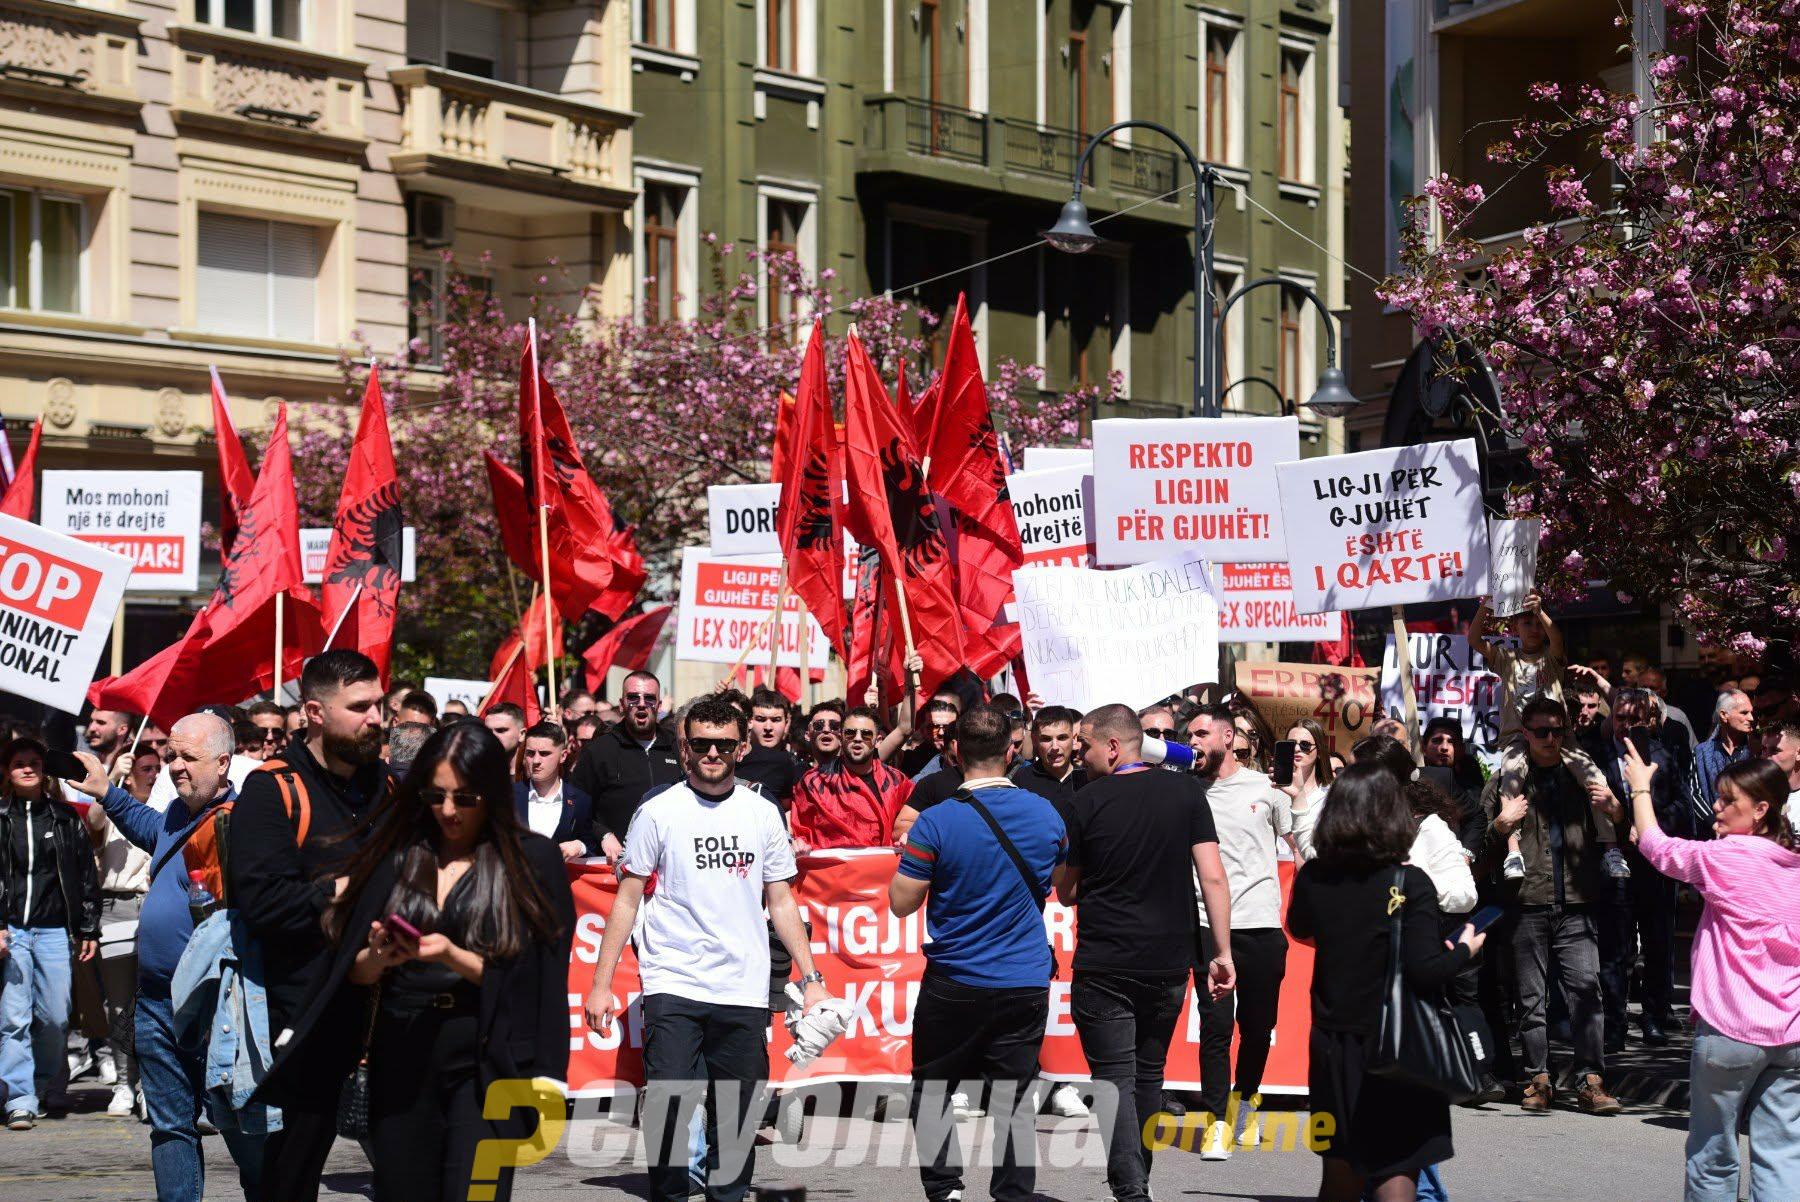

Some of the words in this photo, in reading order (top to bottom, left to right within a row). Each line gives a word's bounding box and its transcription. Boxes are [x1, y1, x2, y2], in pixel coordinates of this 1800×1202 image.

[1130, 442, 1253, 469] RESPEKTO
[1155, 479, 1228, 504] LIGJIN
[1313, 472, 1383, 500] LIGJI
[1391, 466, 1442, 493] PËR
[66, 488, 102, 506] Mos
[107, 488, 169, 506] mohoni
[67, 511, 90, 531] një
[97, 511, 111, 528] të
[117, 511, 165, 532] drejtë
[1117, 509, 1164, 541] PËR
[1173, 507, 1269, 540] GJUHËT!
[1330, 496, 1431, 527] GJUHËT
[1021, 516, 1082, 544] drejtë
[1346, 529, 1423, 557] ËSHTË
[99, 541, 180, 569] UAR!
[722, 570, 757, 585] LIGJI
[760, 570, 787, 588] PË
[1315, 566, 1325, 590] I
[1337, 551, 1463, 589] QARTË!
[704, 588, 759, 606] GJUHËT
[761, 590, 799, 608] ËST
[1218, 602, 1239, 628] EX
[693, 618, 724, 648] LEX
[729, 619, 815, 654] SPECIALI!
[694, 836, 739, 853] FOLI
[696, 852, 755, 870] SHQIP
[800, 903, 934, 956] LIGJI
